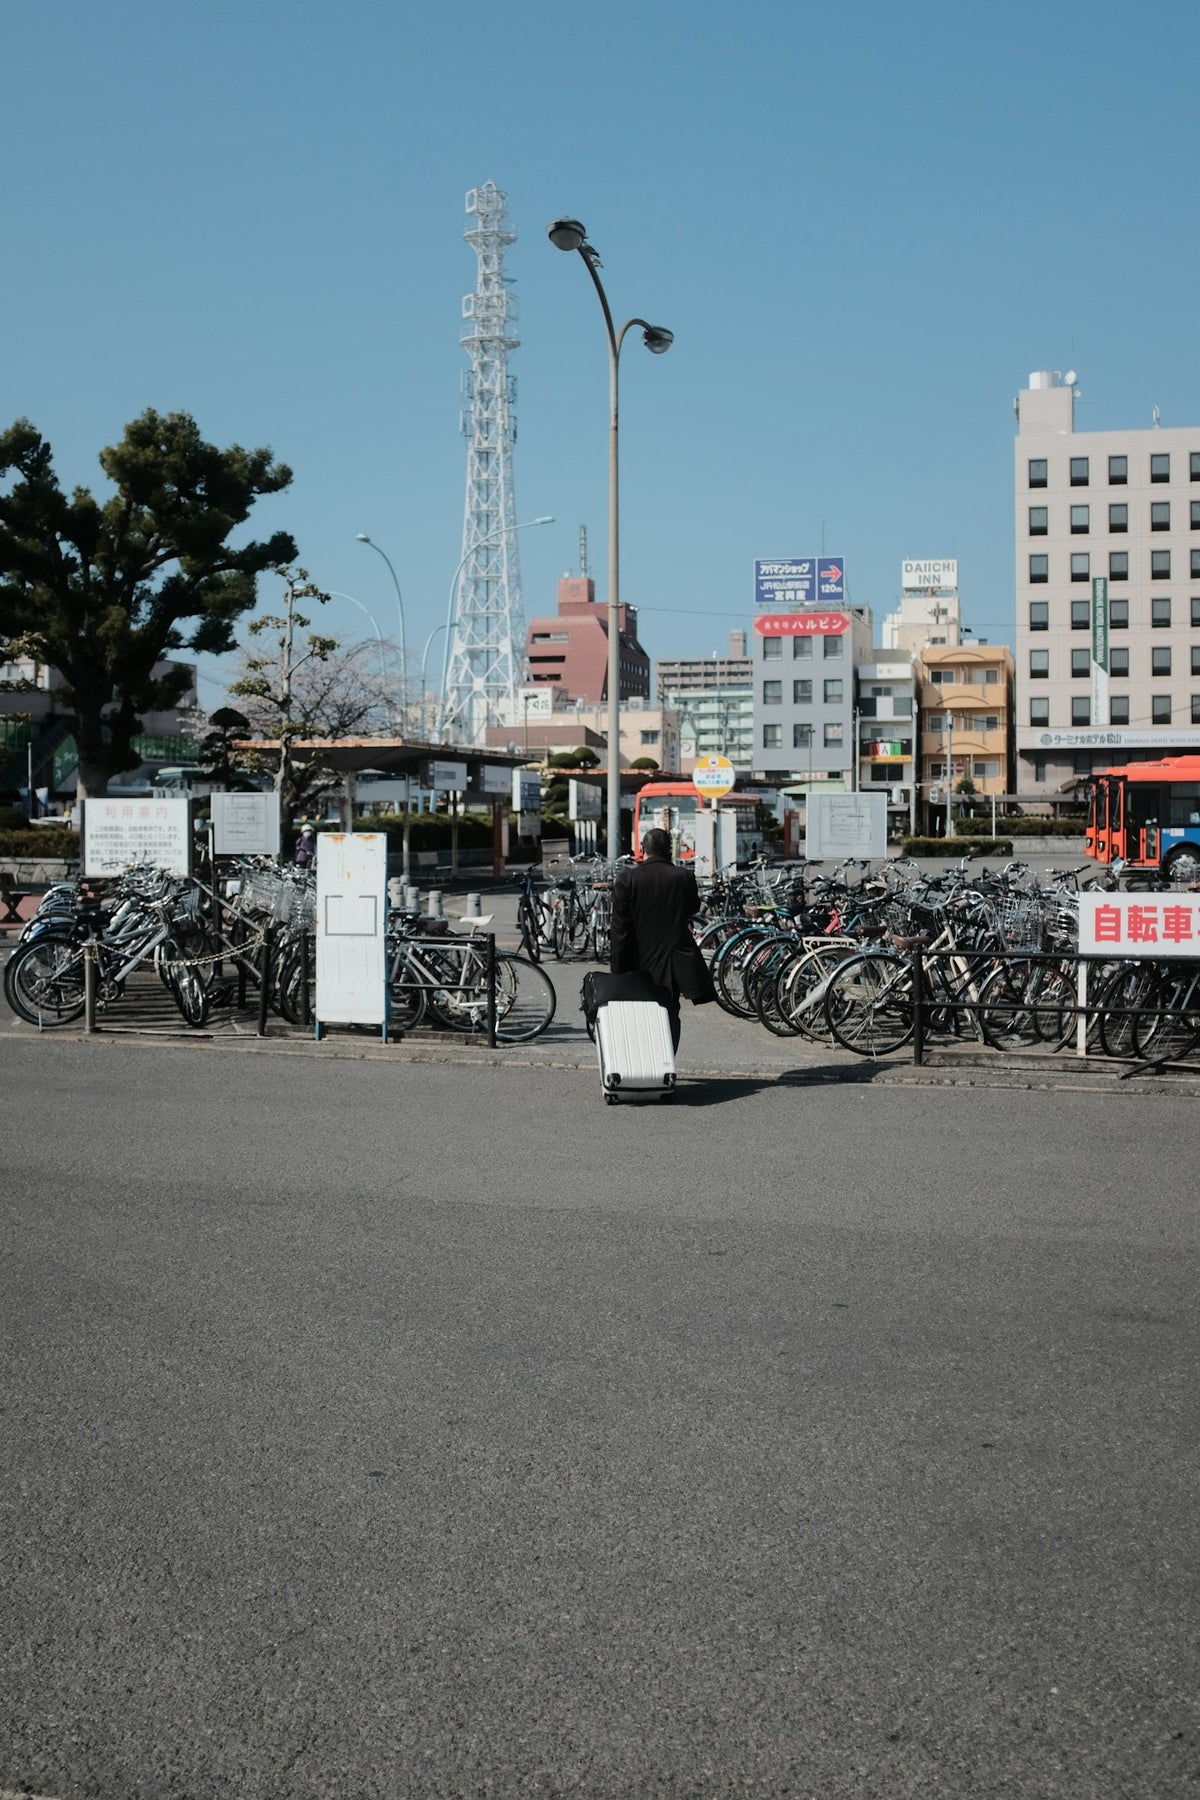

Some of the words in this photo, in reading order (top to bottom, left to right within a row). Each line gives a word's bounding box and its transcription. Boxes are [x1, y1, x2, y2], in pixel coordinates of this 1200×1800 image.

[905, 562, 955, 572] DAIICHI
[918, 574, 941, 584] INN
[821, 583, 843, 593] 120m
[105, 806, 168, 819] 利用案内
[1095, 904, 1200, 944] 自転車
